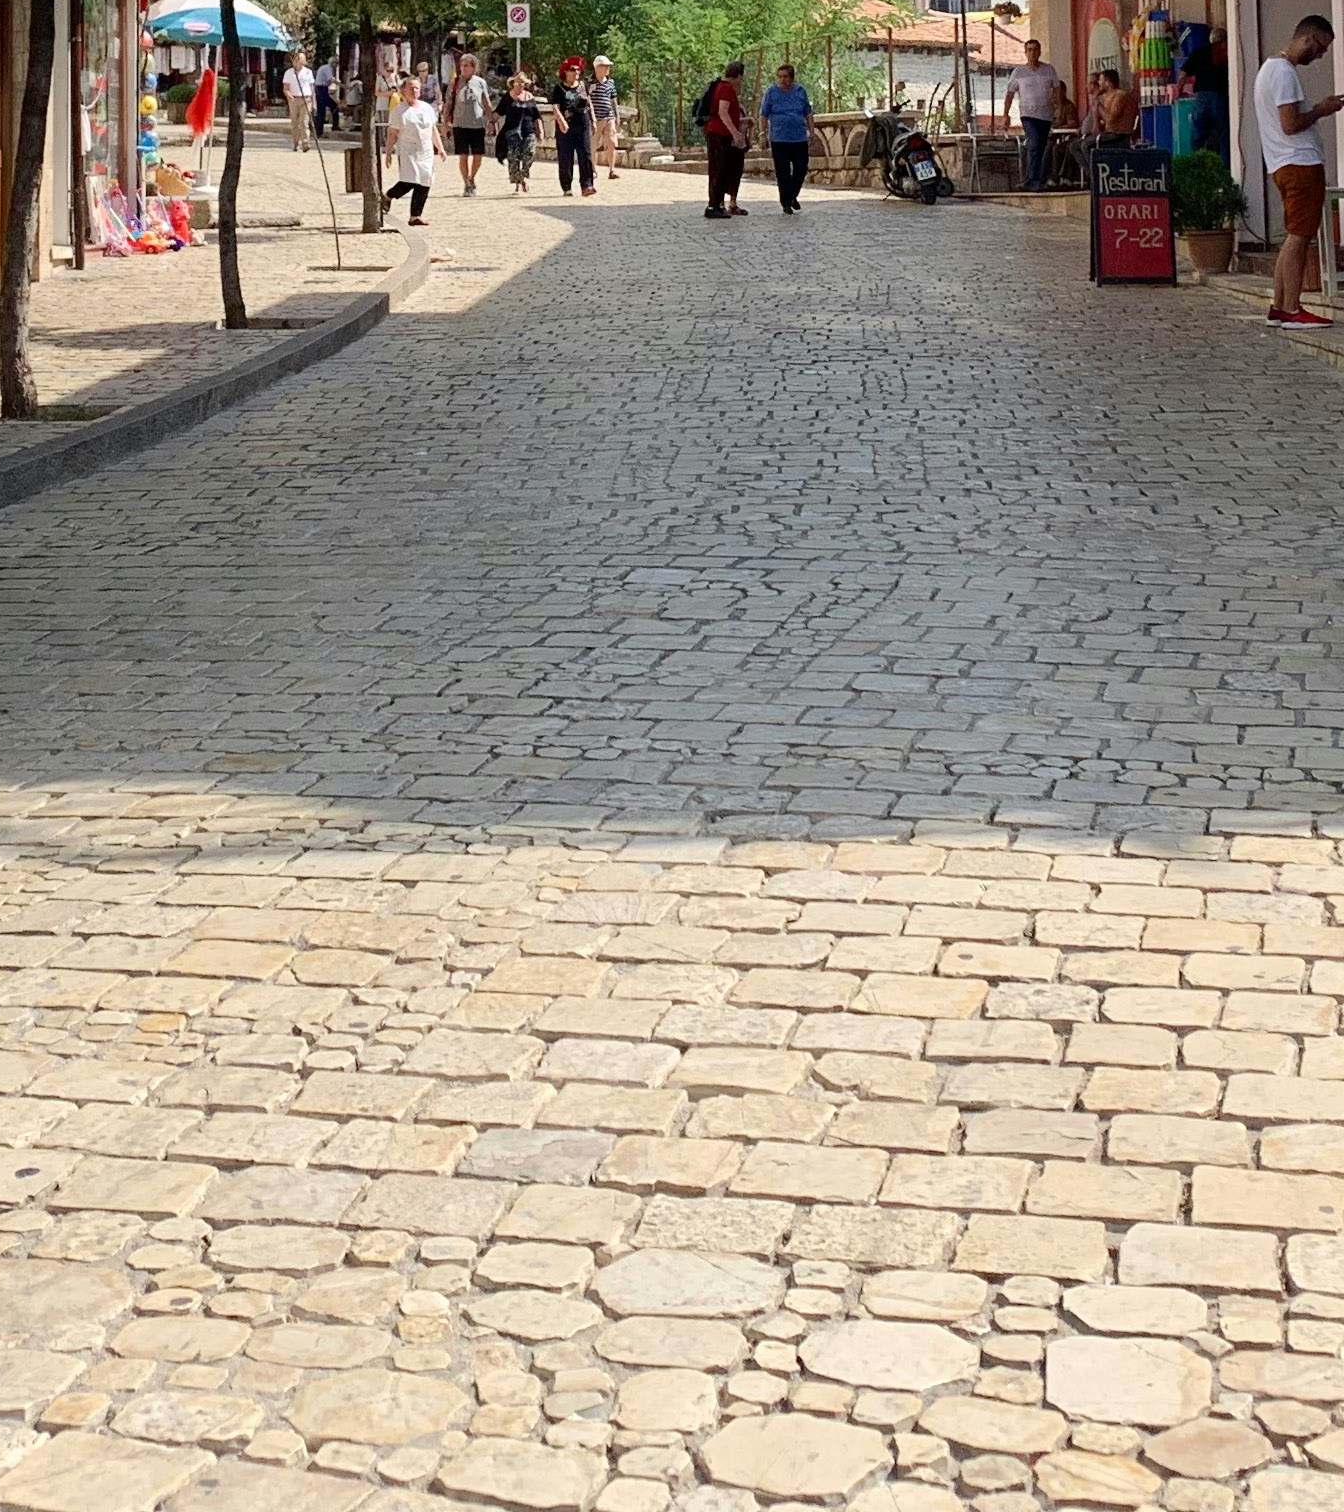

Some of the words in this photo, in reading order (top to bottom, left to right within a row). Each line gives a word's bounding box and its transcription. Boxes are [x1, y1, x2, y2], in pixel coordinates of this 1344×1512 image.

[1096, 162, 1168, 196] Restorant
[1104, 204, 1159, 220] ORARI
[1114, 227, 1164, 249] 7-22
